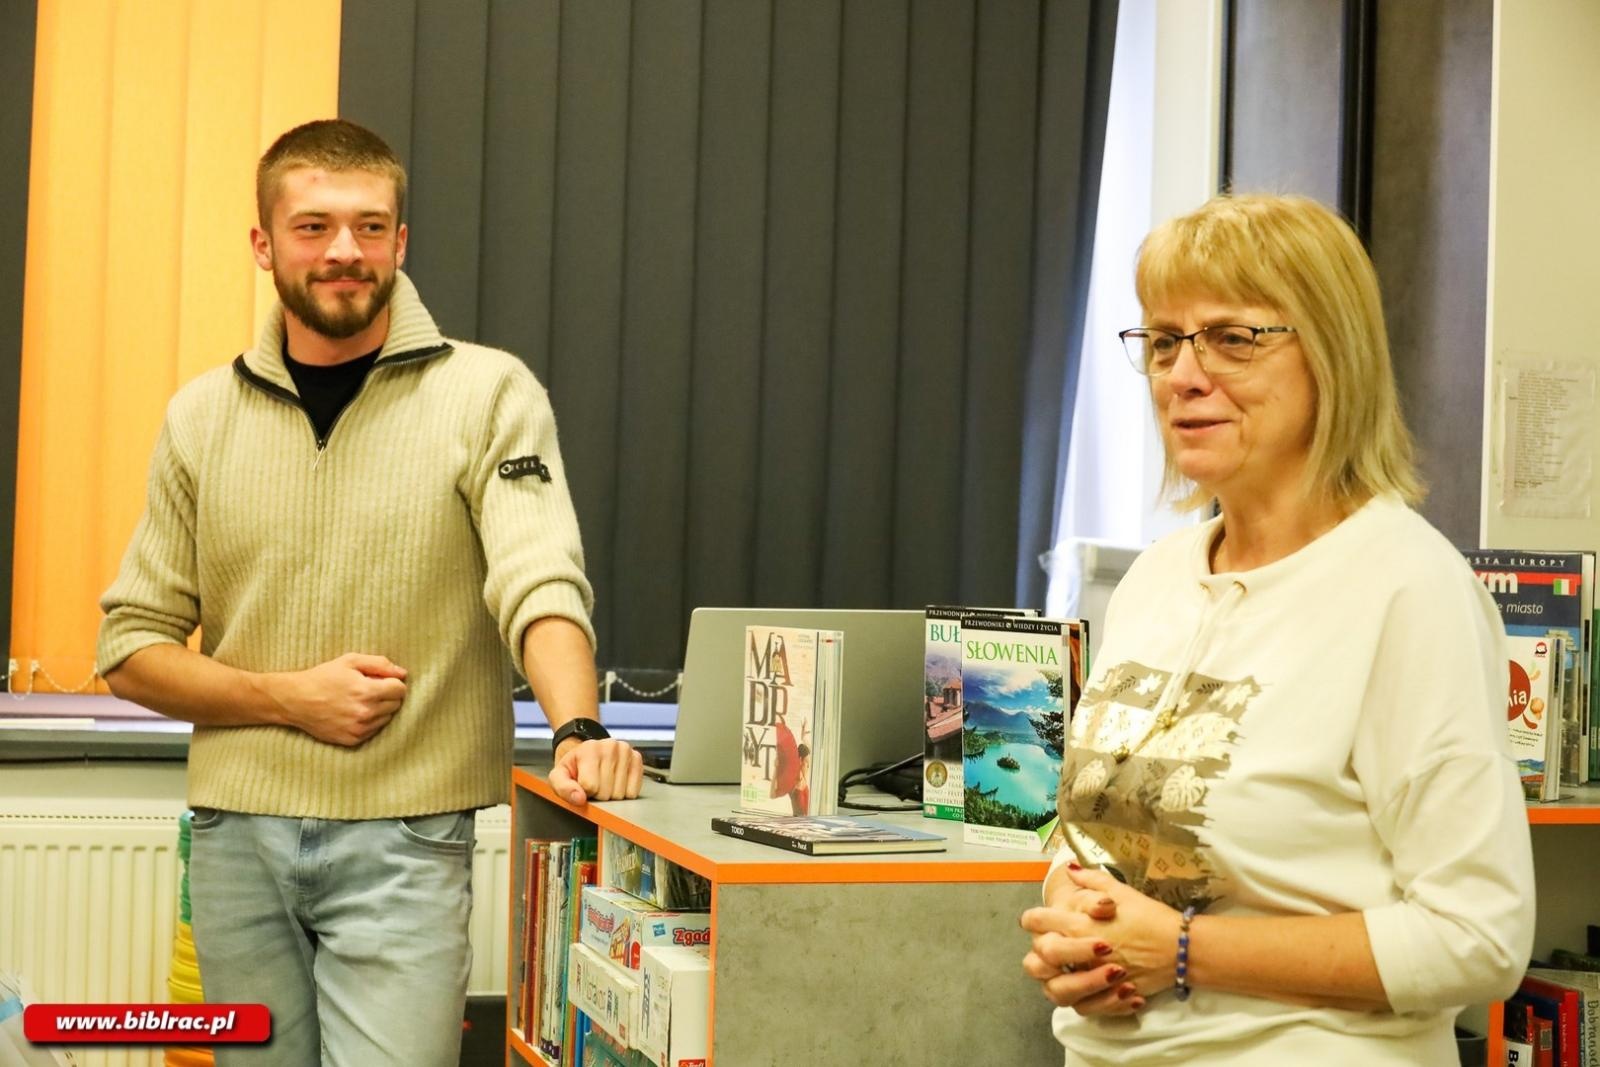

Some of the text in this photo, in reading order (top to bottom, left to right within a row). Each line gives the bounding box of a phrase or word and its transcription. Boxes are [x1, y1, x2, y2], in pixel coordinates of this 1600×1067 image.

[1510, 558, 1566, 567] EUROPY
[1506, 601, 1544, 614] miasto
[965, 620, 1005, 628] PRZEWODNIKI
[1013, 622, 1035, 631] WIEDZY
[1040, 622, 1059, 632] ŻYCIA
[966, 640, 1059, 666] SŁOWENIA
[731, 826, 745, 836] TOKIO
[673, 928, 710, 946] Zgad
[1587, 1000, 1600, 1067] Dobranoc
